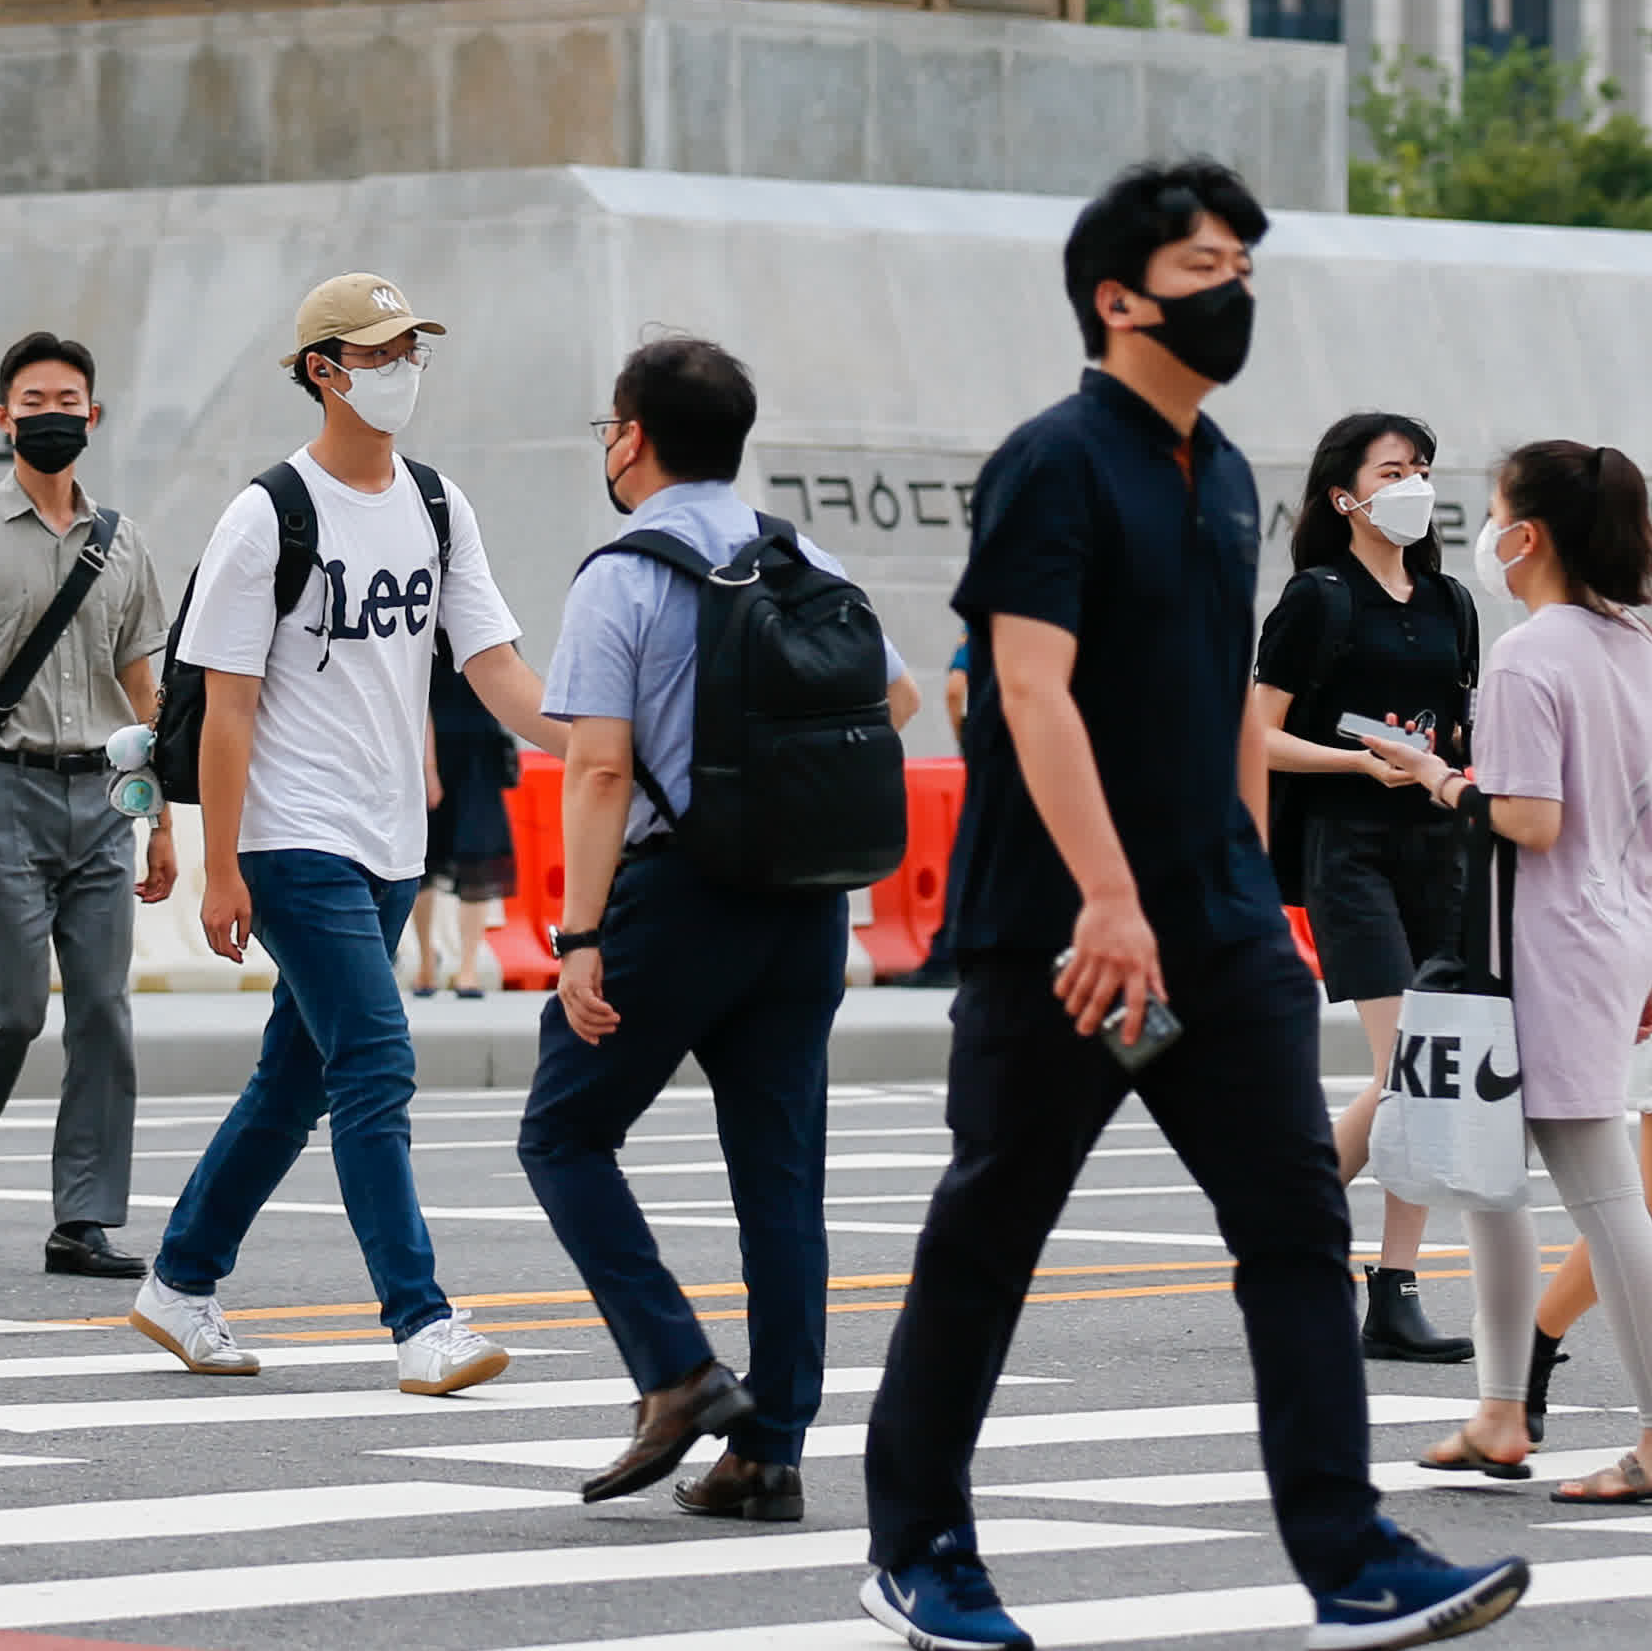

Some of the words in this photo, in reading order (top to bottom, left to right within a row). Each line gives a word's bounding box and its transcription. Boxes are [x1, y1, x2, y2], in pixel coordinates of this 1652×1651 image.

[372, 287, 403, 310] NY
[326, 559, 433, 639] Lee
[1382, 1028, 1462, 1099] KE
